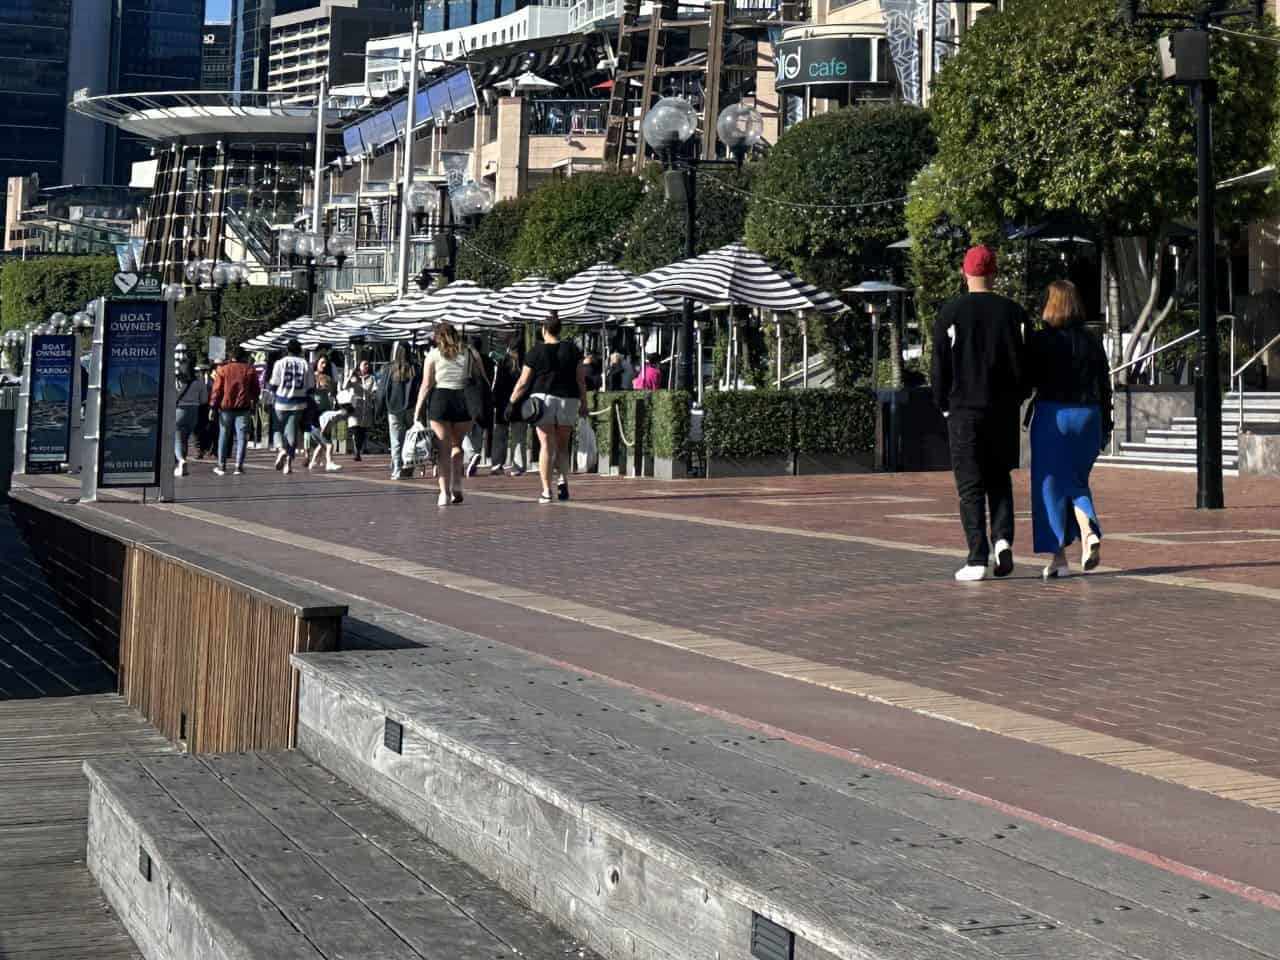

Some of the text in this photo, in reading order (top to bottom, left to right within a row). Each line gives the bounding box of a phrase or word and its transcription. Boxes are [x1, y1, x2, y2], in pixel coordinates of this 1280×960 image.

[137, 278, 158, 286] AED
[120, 312, 153, 321] BOAT
[110, 321, 161, 331] OWNERS
[111, 347, 157, 357] MARINA
